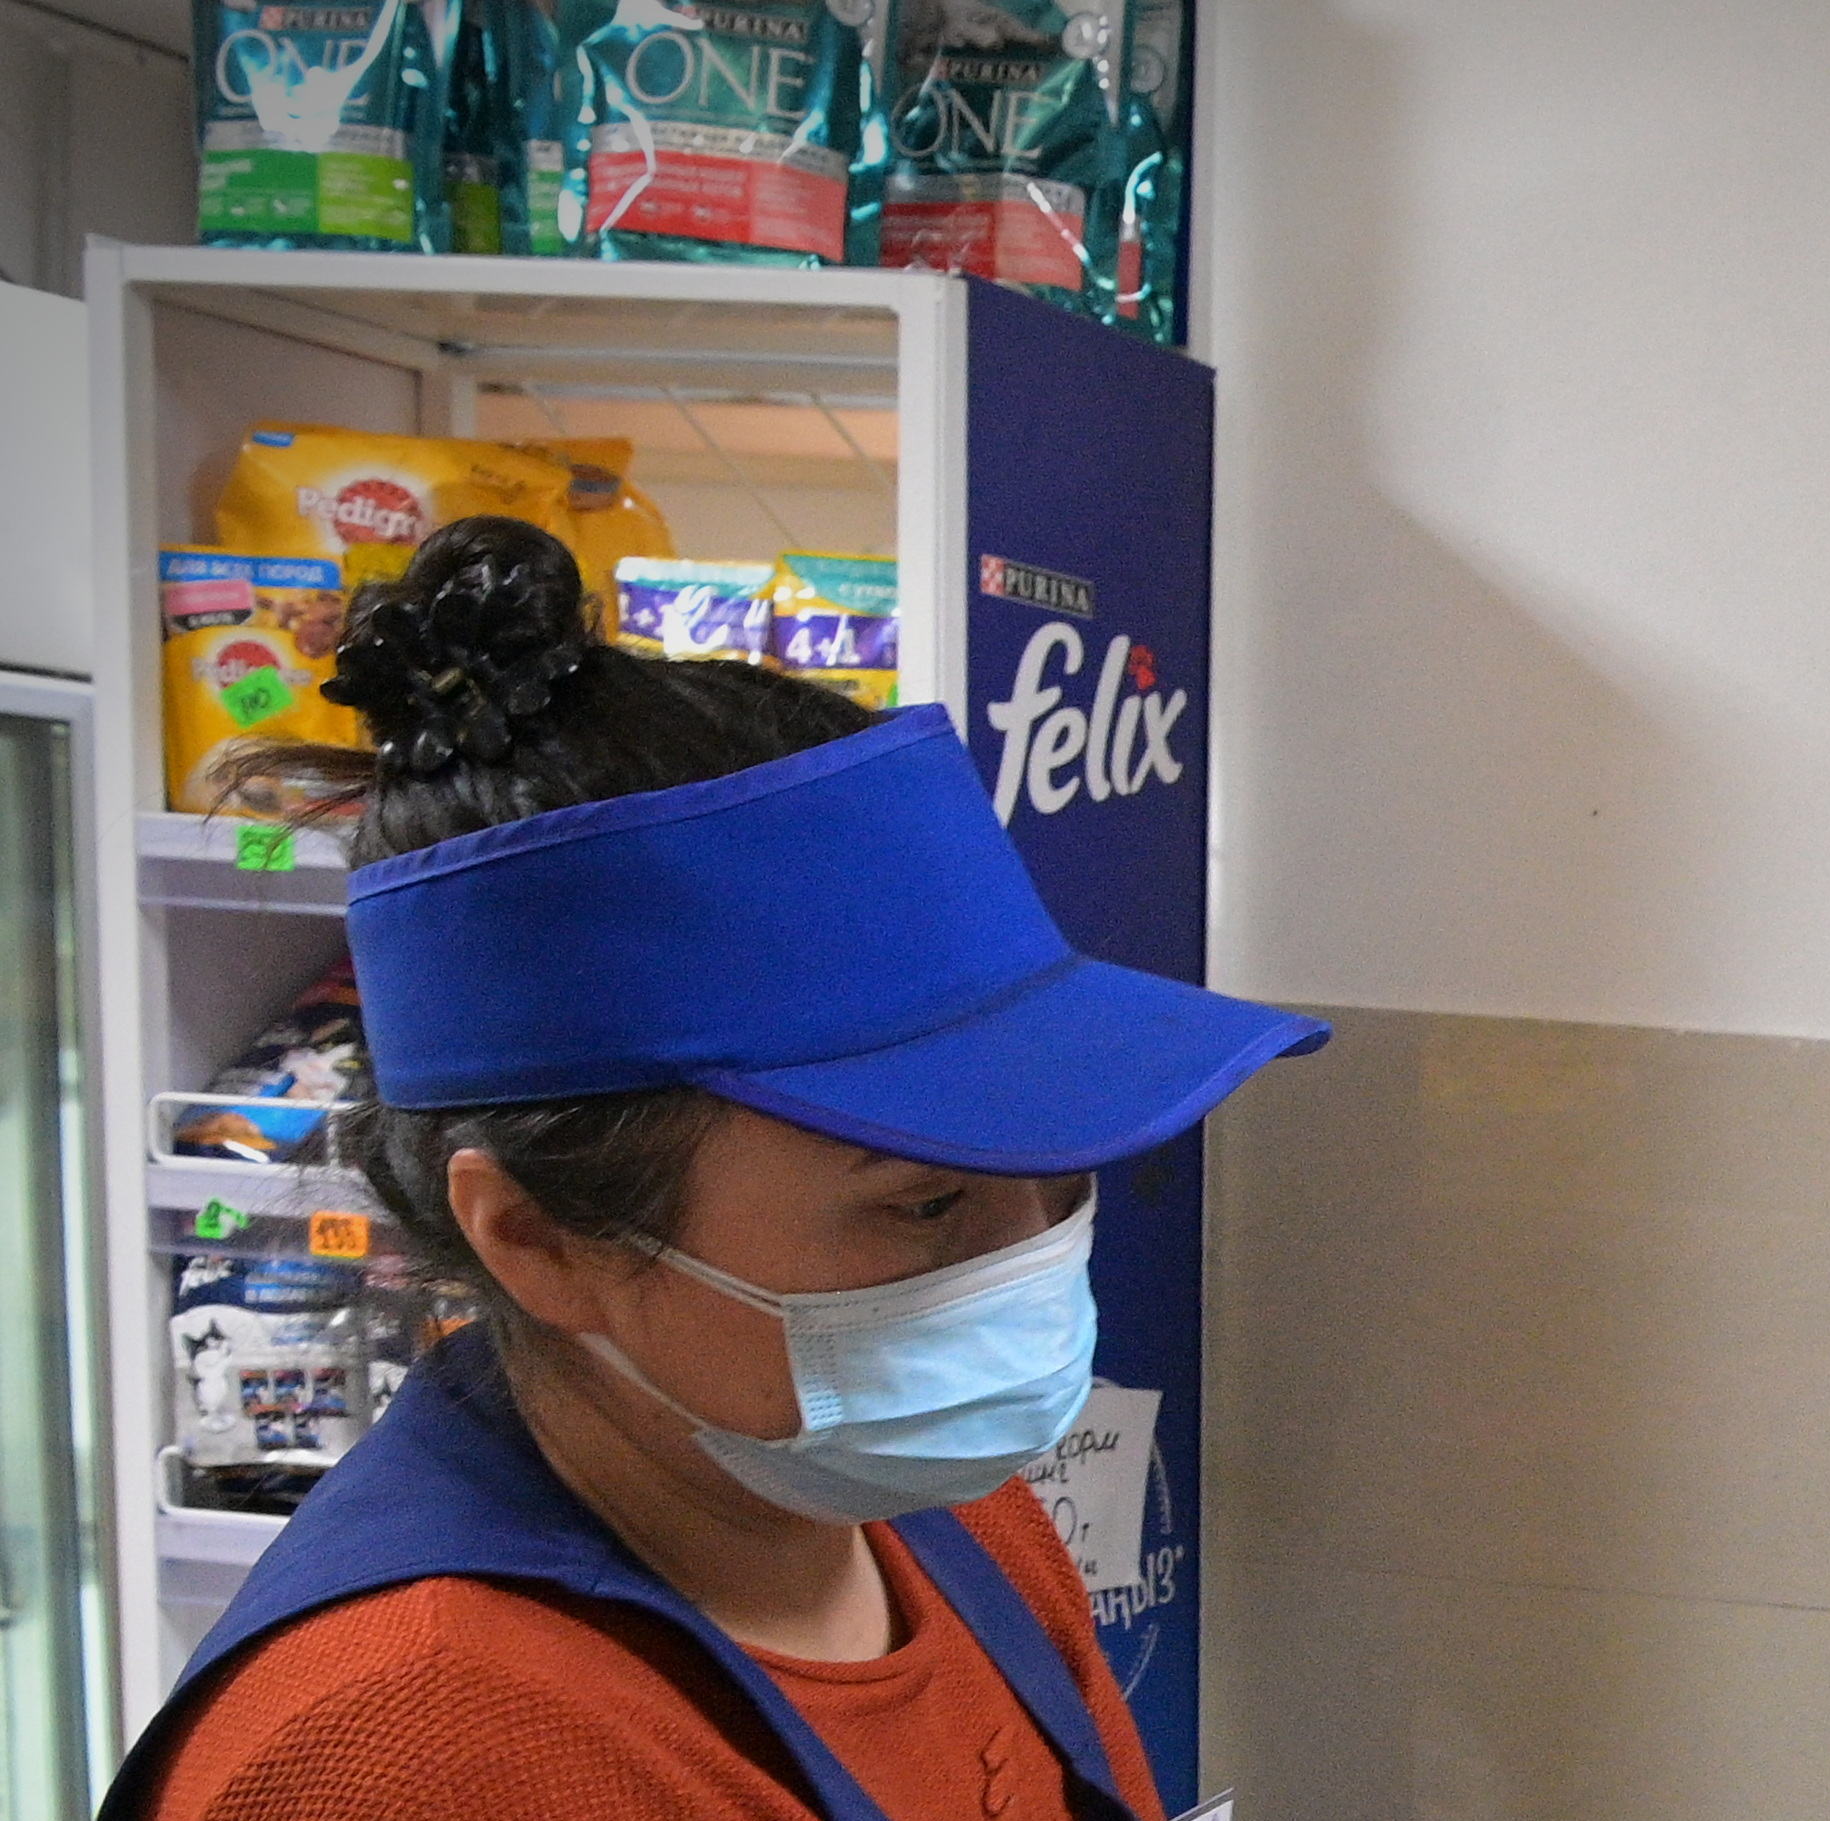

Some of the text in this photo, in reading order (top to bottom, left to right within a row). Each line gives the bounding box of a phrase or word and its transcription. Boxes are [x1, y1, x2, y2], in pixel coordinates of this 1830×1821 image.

[625, 30, 815, 119] ONE
[890, 86, 1050, 159] ONE
[1004, 565, 1090, 613] PURINA
[986, 620, 1188, 832] felix
